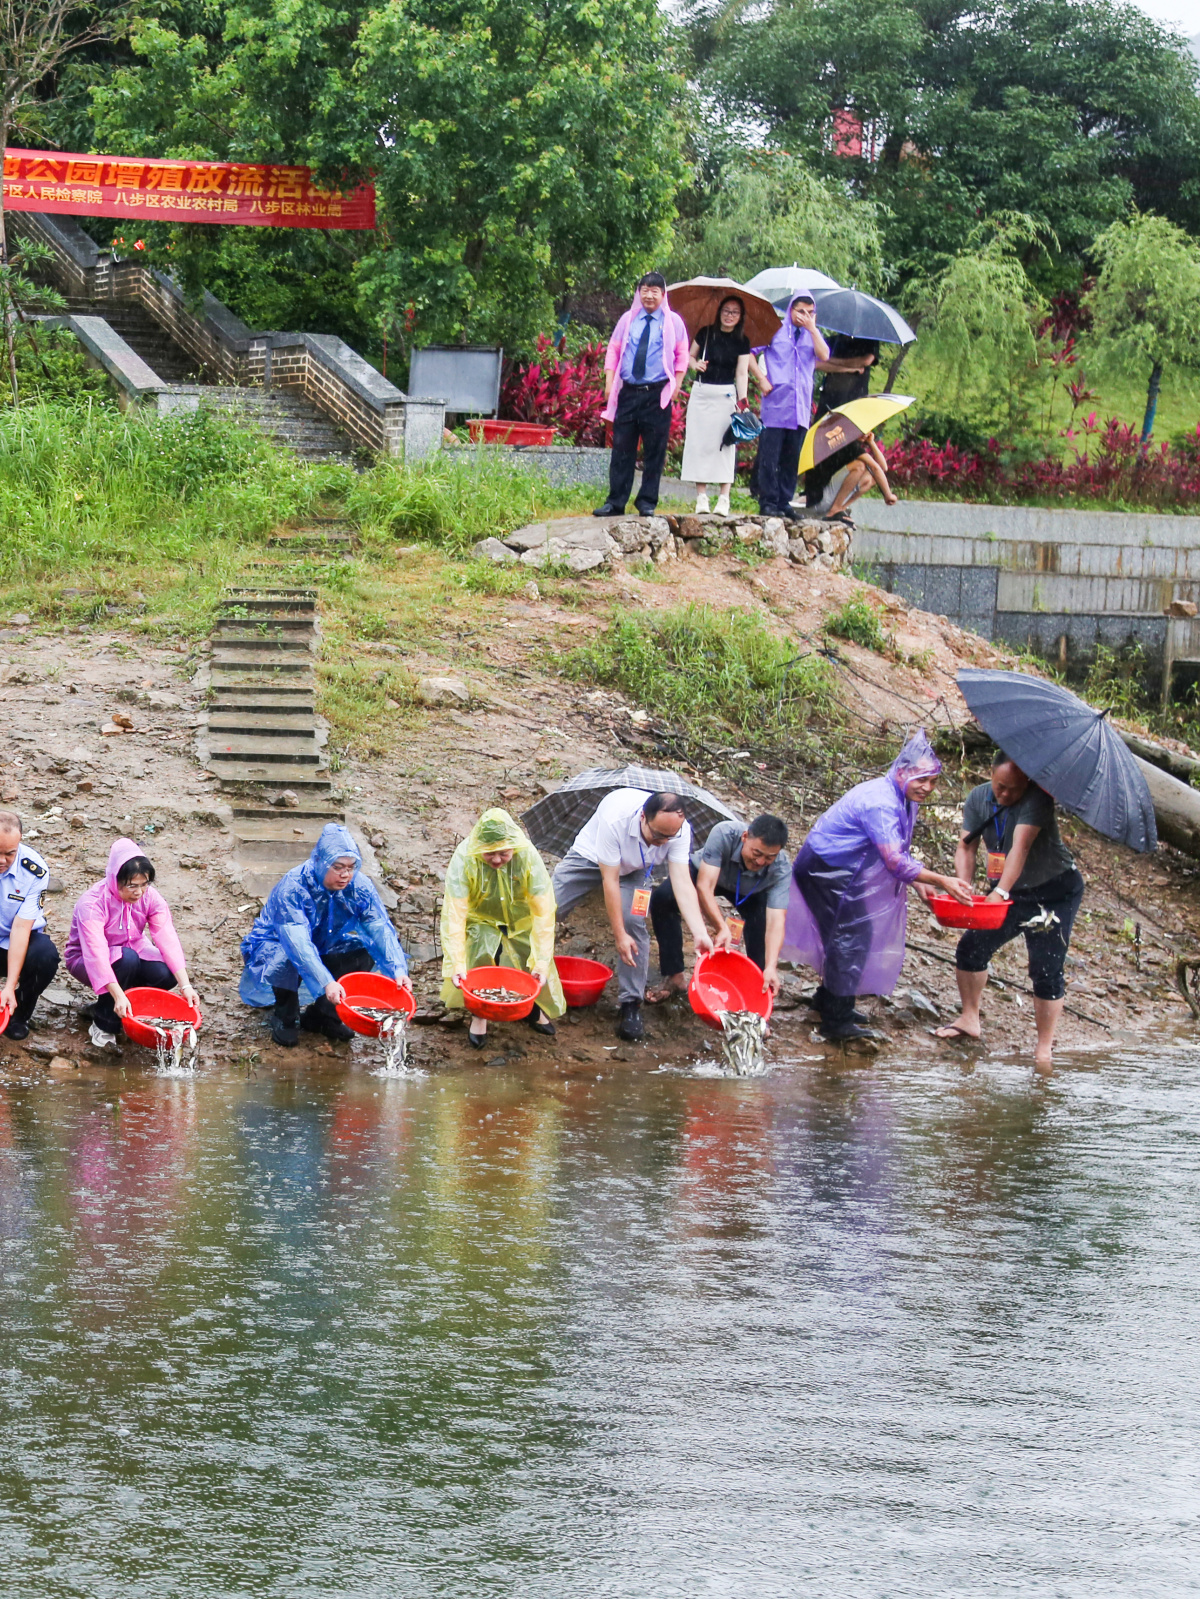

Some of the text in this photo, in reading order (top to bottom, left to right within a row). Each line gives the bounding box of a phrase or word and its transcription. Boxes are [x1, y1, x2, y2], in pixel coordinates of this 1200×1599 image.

[114, 191, 238, 213] 八步区农业农村局
[250, 201, 342, 217] 八步区林业局
